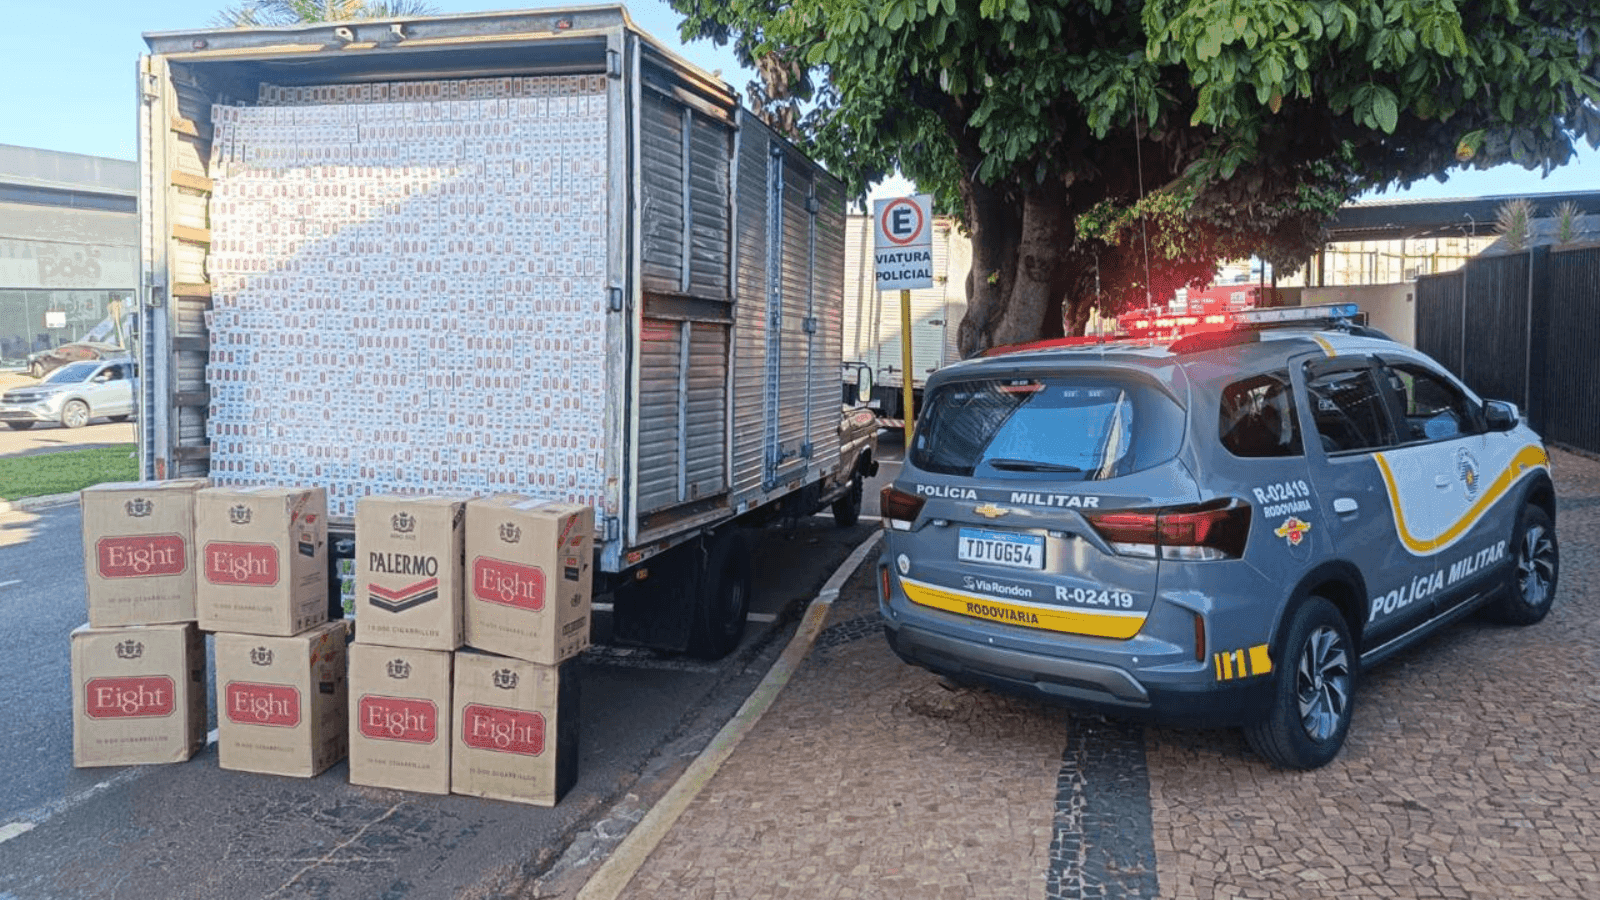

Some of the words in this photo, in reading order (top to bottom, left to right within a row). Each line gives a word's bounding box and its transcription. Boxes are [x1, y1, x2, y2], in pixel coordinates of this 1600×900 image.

[893, 209, 912, 234] E
[875, 251, 931, 264] VIATURA
[876, 268, 933, 281] POLICIAL
[916, 484, 977, 500] POLÍCIA
[1010, 491, 1100, 508] MILITAR
[1252, 480, 1310, 504] R-02419
[107, 543, 176, 573] Eight
[212, 551, 270, 580] Eight
[369, 551, 439, 577] PALERMO
[482, 567, 536, 602] Eight
[1369, 569, 1443, 622] POLÍCIA
[1447, 540, 1506, 585] MILITAR
[1055, 585, 1134, 608] R-02419
[95, 685, 165, 713] Eight
[234, 691, 291, 721] Eight
[368, 705, 428, 737] Eight
[472, 714, 535, 747] Eight
